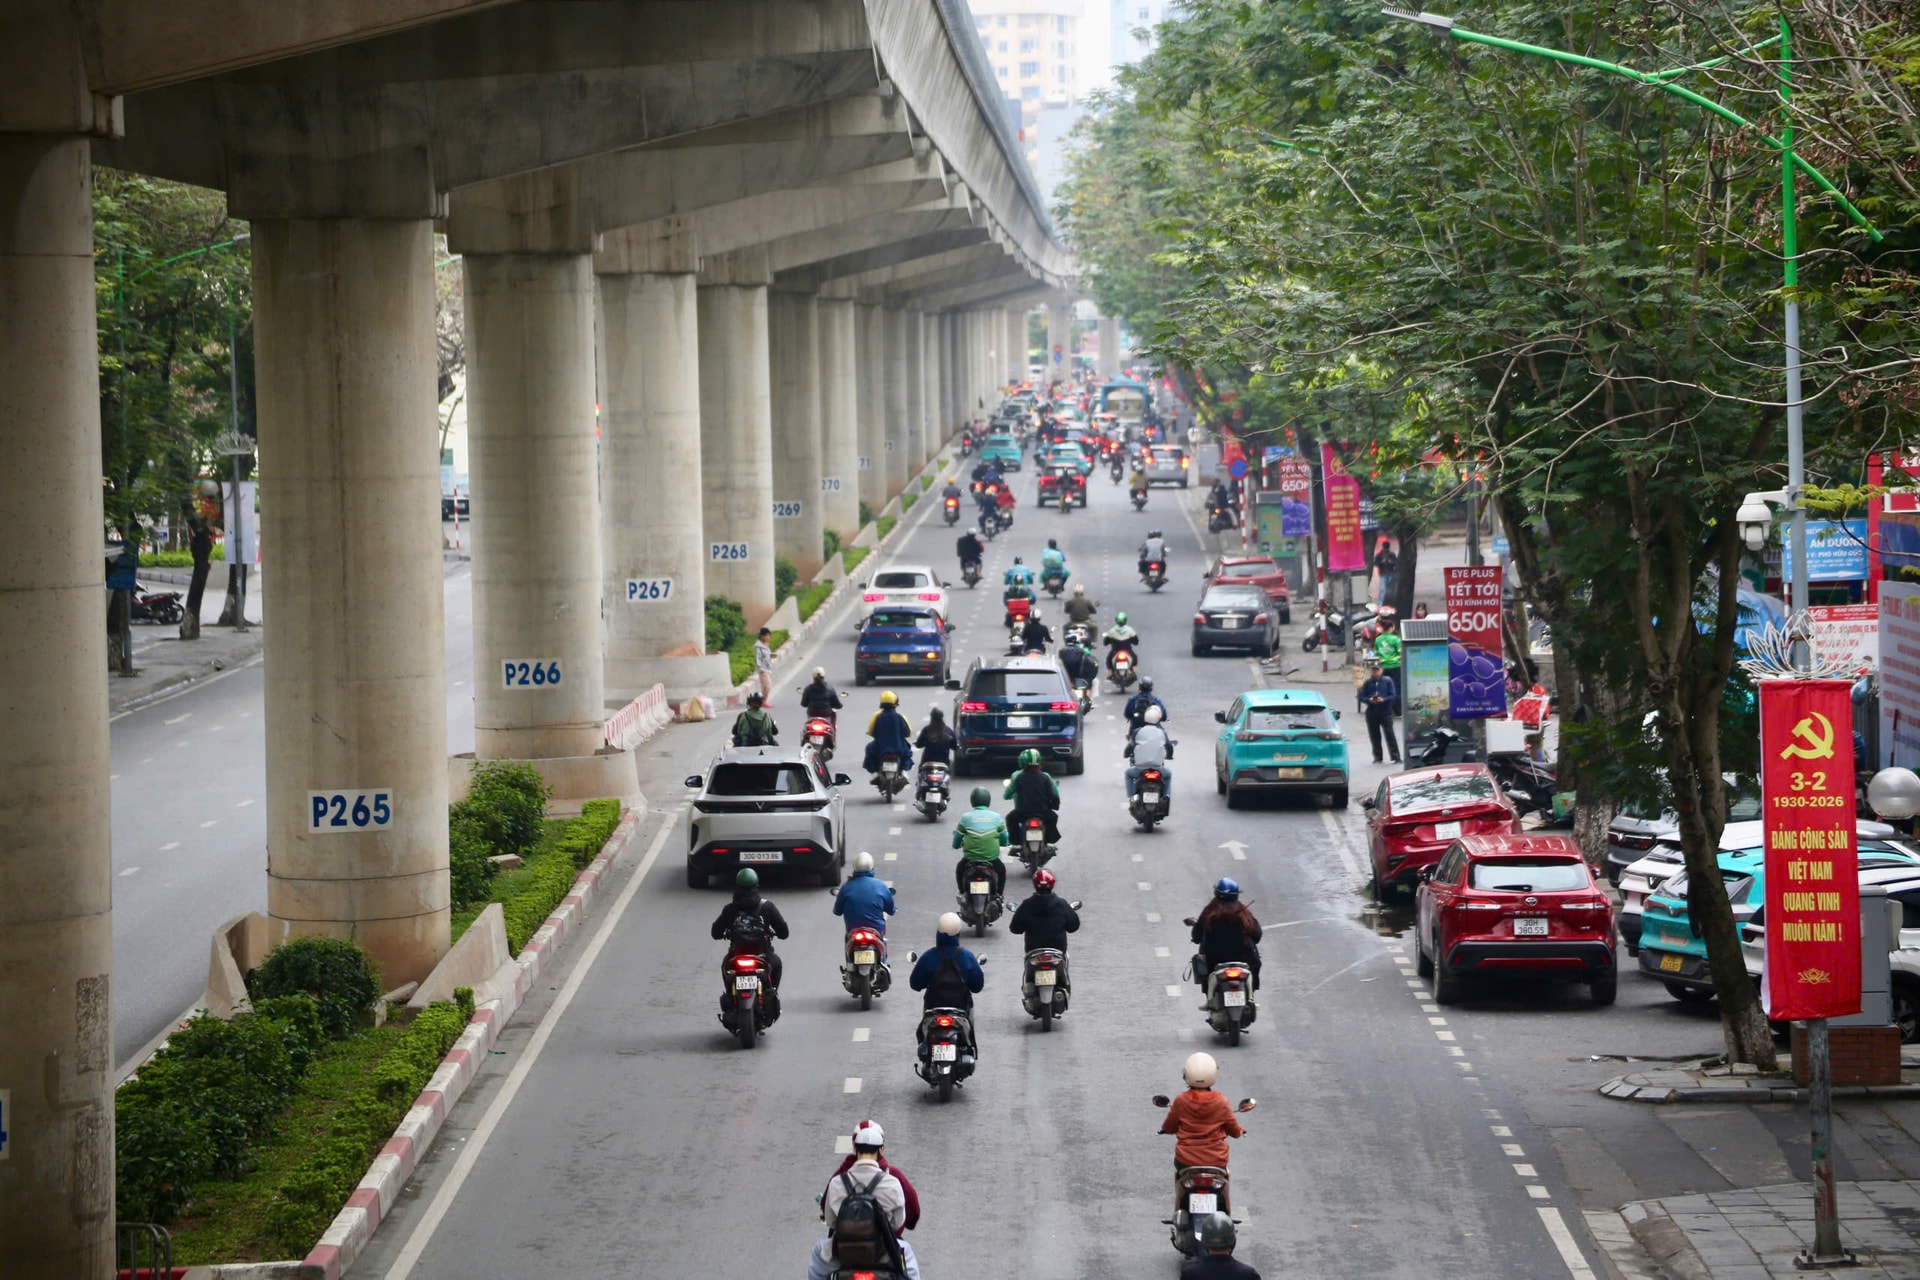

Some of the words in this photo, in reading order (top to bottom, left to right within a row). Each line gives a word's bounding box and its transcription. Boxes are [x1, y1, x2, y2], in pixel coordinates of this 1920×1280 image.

[821, 479, 840, 490] 270
[712, 543, 747, 560] P268
[1451, 569, 1469, 578] EYE
[1470, 569, 1494, 578] PLUS
[628, 580, 671, 599] P267
[1448, 582, 1472, 596] TẾT
[1475, 583, 1499, 596] TỚI
[1464, 598, 1482, 606] KÍNH
[1484, 598, 1499, 606] MỚI
[1449, 611, 1499, 632] 650K
[505, 661, 561, 686] P266
[1790, 771, 1827, 791] 3-2
[312, 793, 390, 827] P265
[1773, 796, 1844, 808] 1930-2026
[1771, 822, 1798, 849] ĐẢNG
[1799, 826, 1826, 854] CỘNG
[1828, 822, 1848, 849] SẢN
[1787, 857, 1808, 884] VIỆT
[1810, 861, 1832, 880] NAM
[1783, 892, 1815, 912] QUANG
[1816, 892, 1841, 911] VINH
[1782, 919, 1811, 941] MUÔN
[1813, 919, 1836, 941] NĂM
